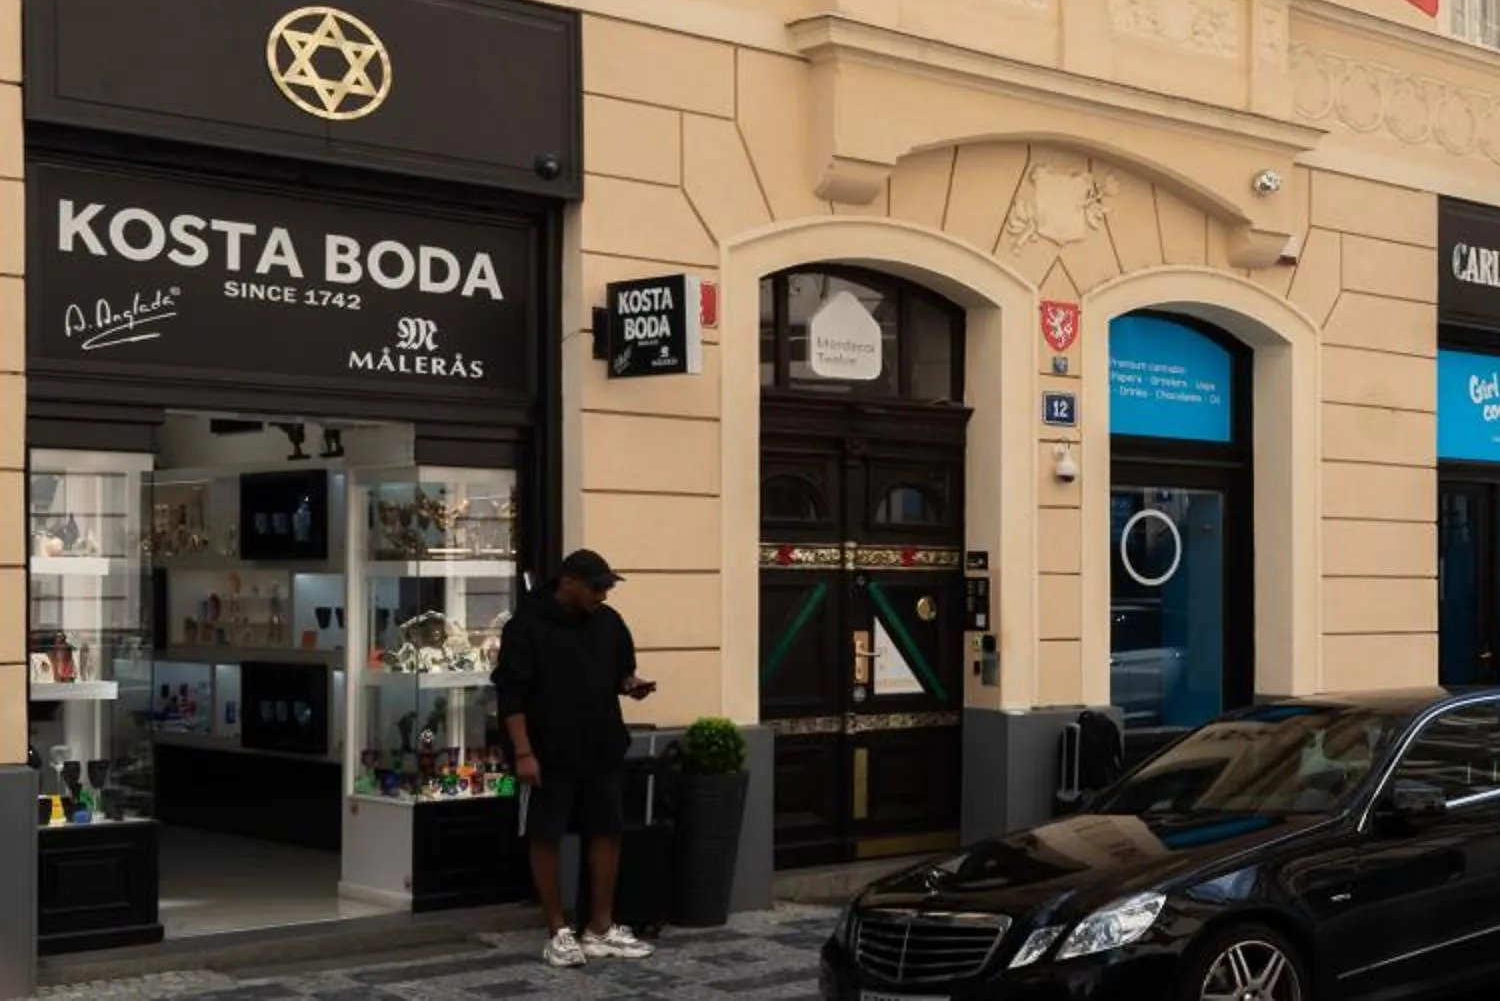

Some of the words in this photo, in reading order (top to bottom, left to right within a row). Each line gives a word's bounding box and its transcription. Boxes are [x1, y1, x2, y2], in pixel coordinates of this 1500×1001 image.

[59, 199, 304, 278] KOSTA
[325, 234, 503, 300] BODA
[224, 280, 297, 303] SINCE
[304, 290, 361, 310] 1742
[618, 287, 673, 314] KOSTA
[624, 315, 671, 341] BODA
[349, 347, 484, 378] MÅLERÅS
[1469, 373, 1499, 404] Girl
[1053, 399, 1068, 418] 12
